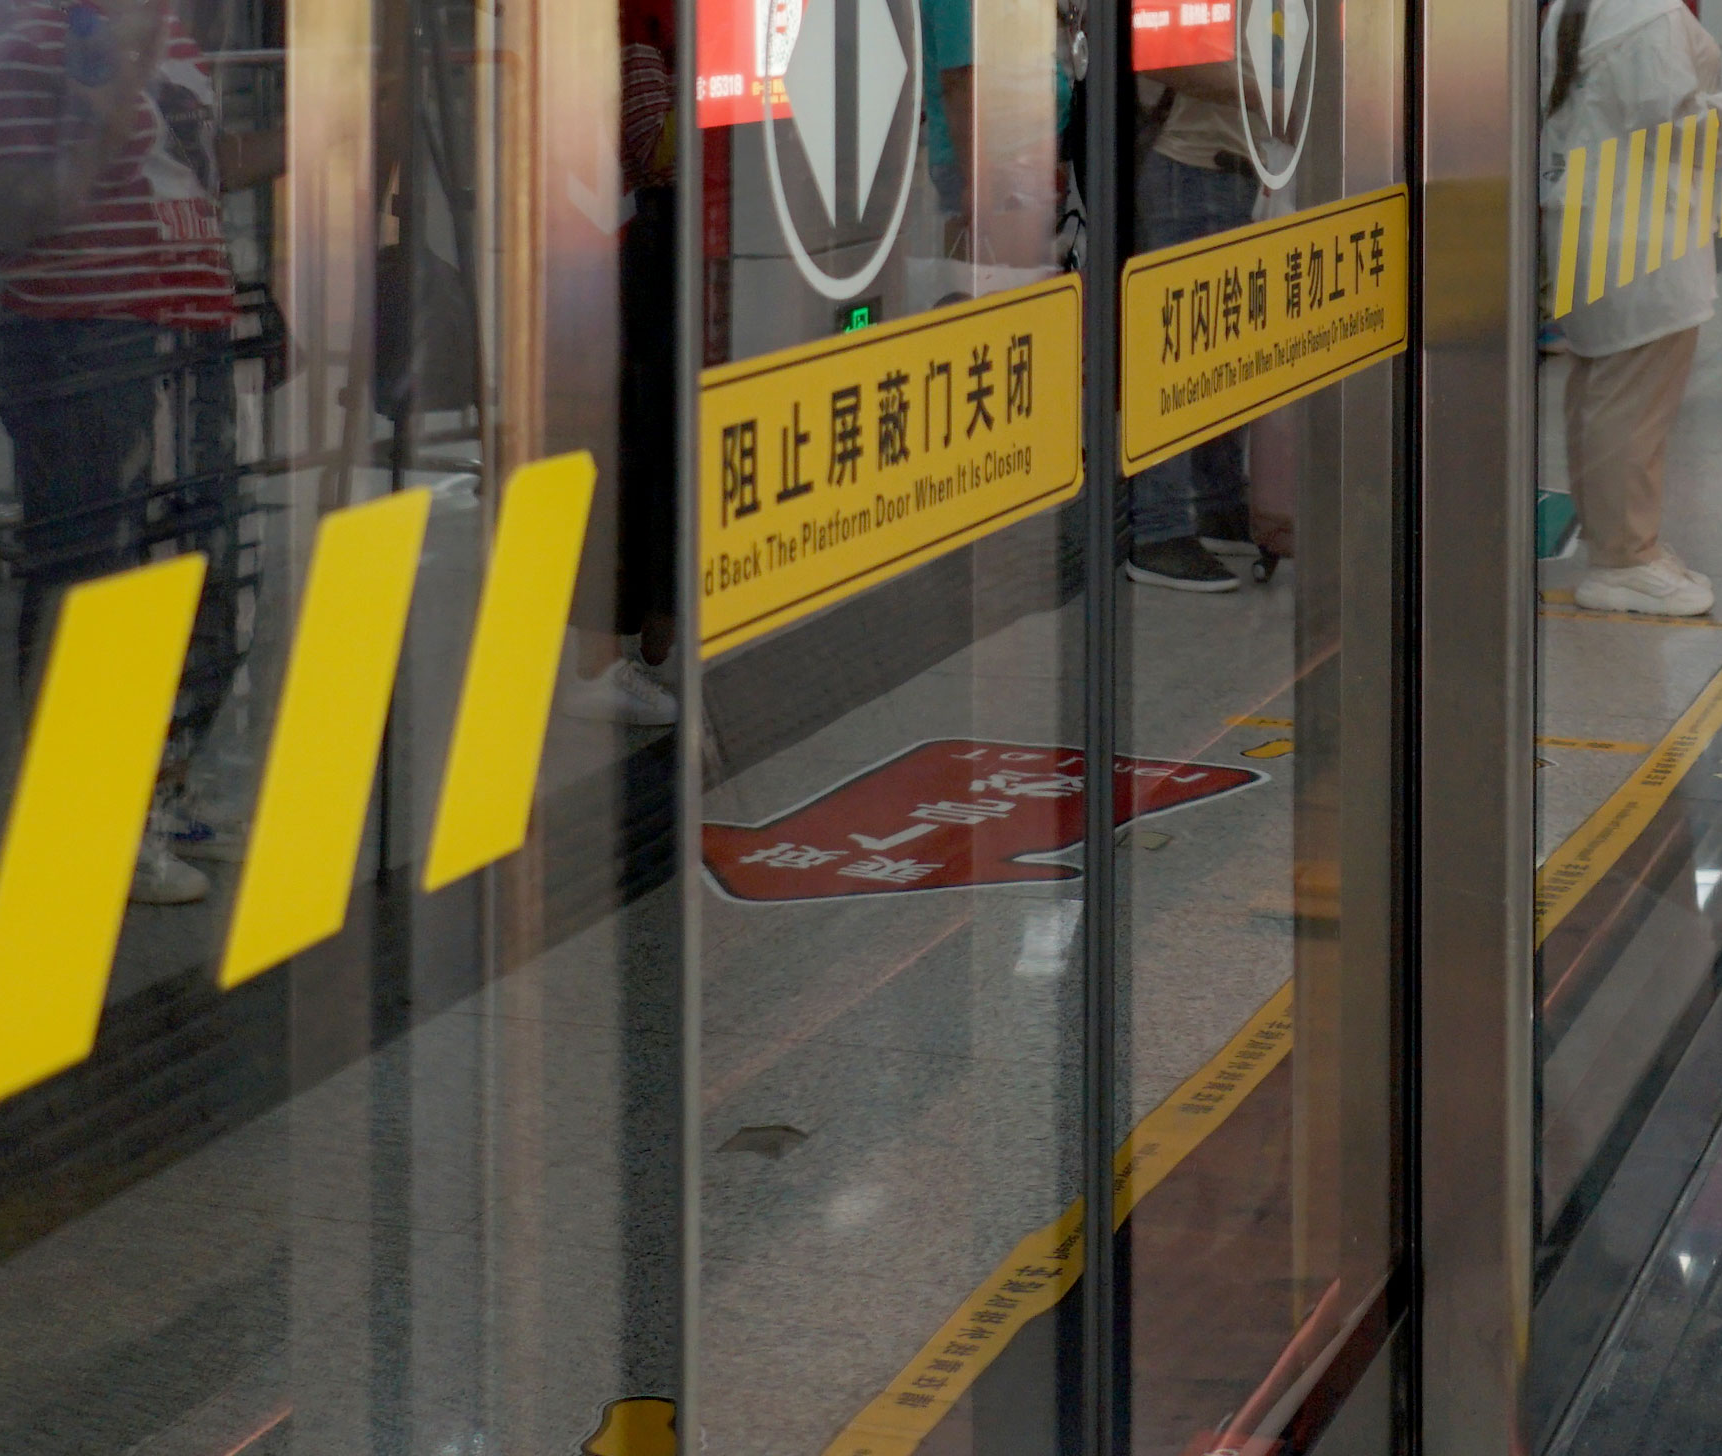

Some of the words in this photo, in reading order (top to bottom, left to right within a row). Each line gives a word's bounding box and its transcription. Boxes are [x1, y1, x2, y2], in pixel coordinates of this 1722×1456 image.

[1160, 257, 1268, 365] 灯闪/铃响
[1284, 221, 1386, 318] 请勿上下车
[1160, 387, 1172, 416] Do
[1172, 382, 1186, 410] Not
[1187, 376, 1200, 405] Get
[1225, 360, 1237, 387] The
[1238, 356, 1255, 385] Train
[1255, 348, 1274, 377] When
[1274, 342, 1286, 368] The
[1286, 337, 1302, 368] Light
[1307, 327, 1331, 354] Flashing
[1331, 323, 1339, 344] Or
[1339, 317, 1350, 341] The
[1350, 312, 1360, 338] Bell
[1365, 304, 1385, 331] Ringing
[720, 333, 1034, 529] 阻止屏蔽门关闭
[718, 542, 763, 593] Back
[766, 532, 797, 568] The
[802, 507, 872, 558] Platform
[876, 493, 912, 528] Door
[914, 472, 955, 512] When
[957, 463, 968, 495] It
[970, 459, 982, 488] Is
[984, 444, 1033, 482] Closing
